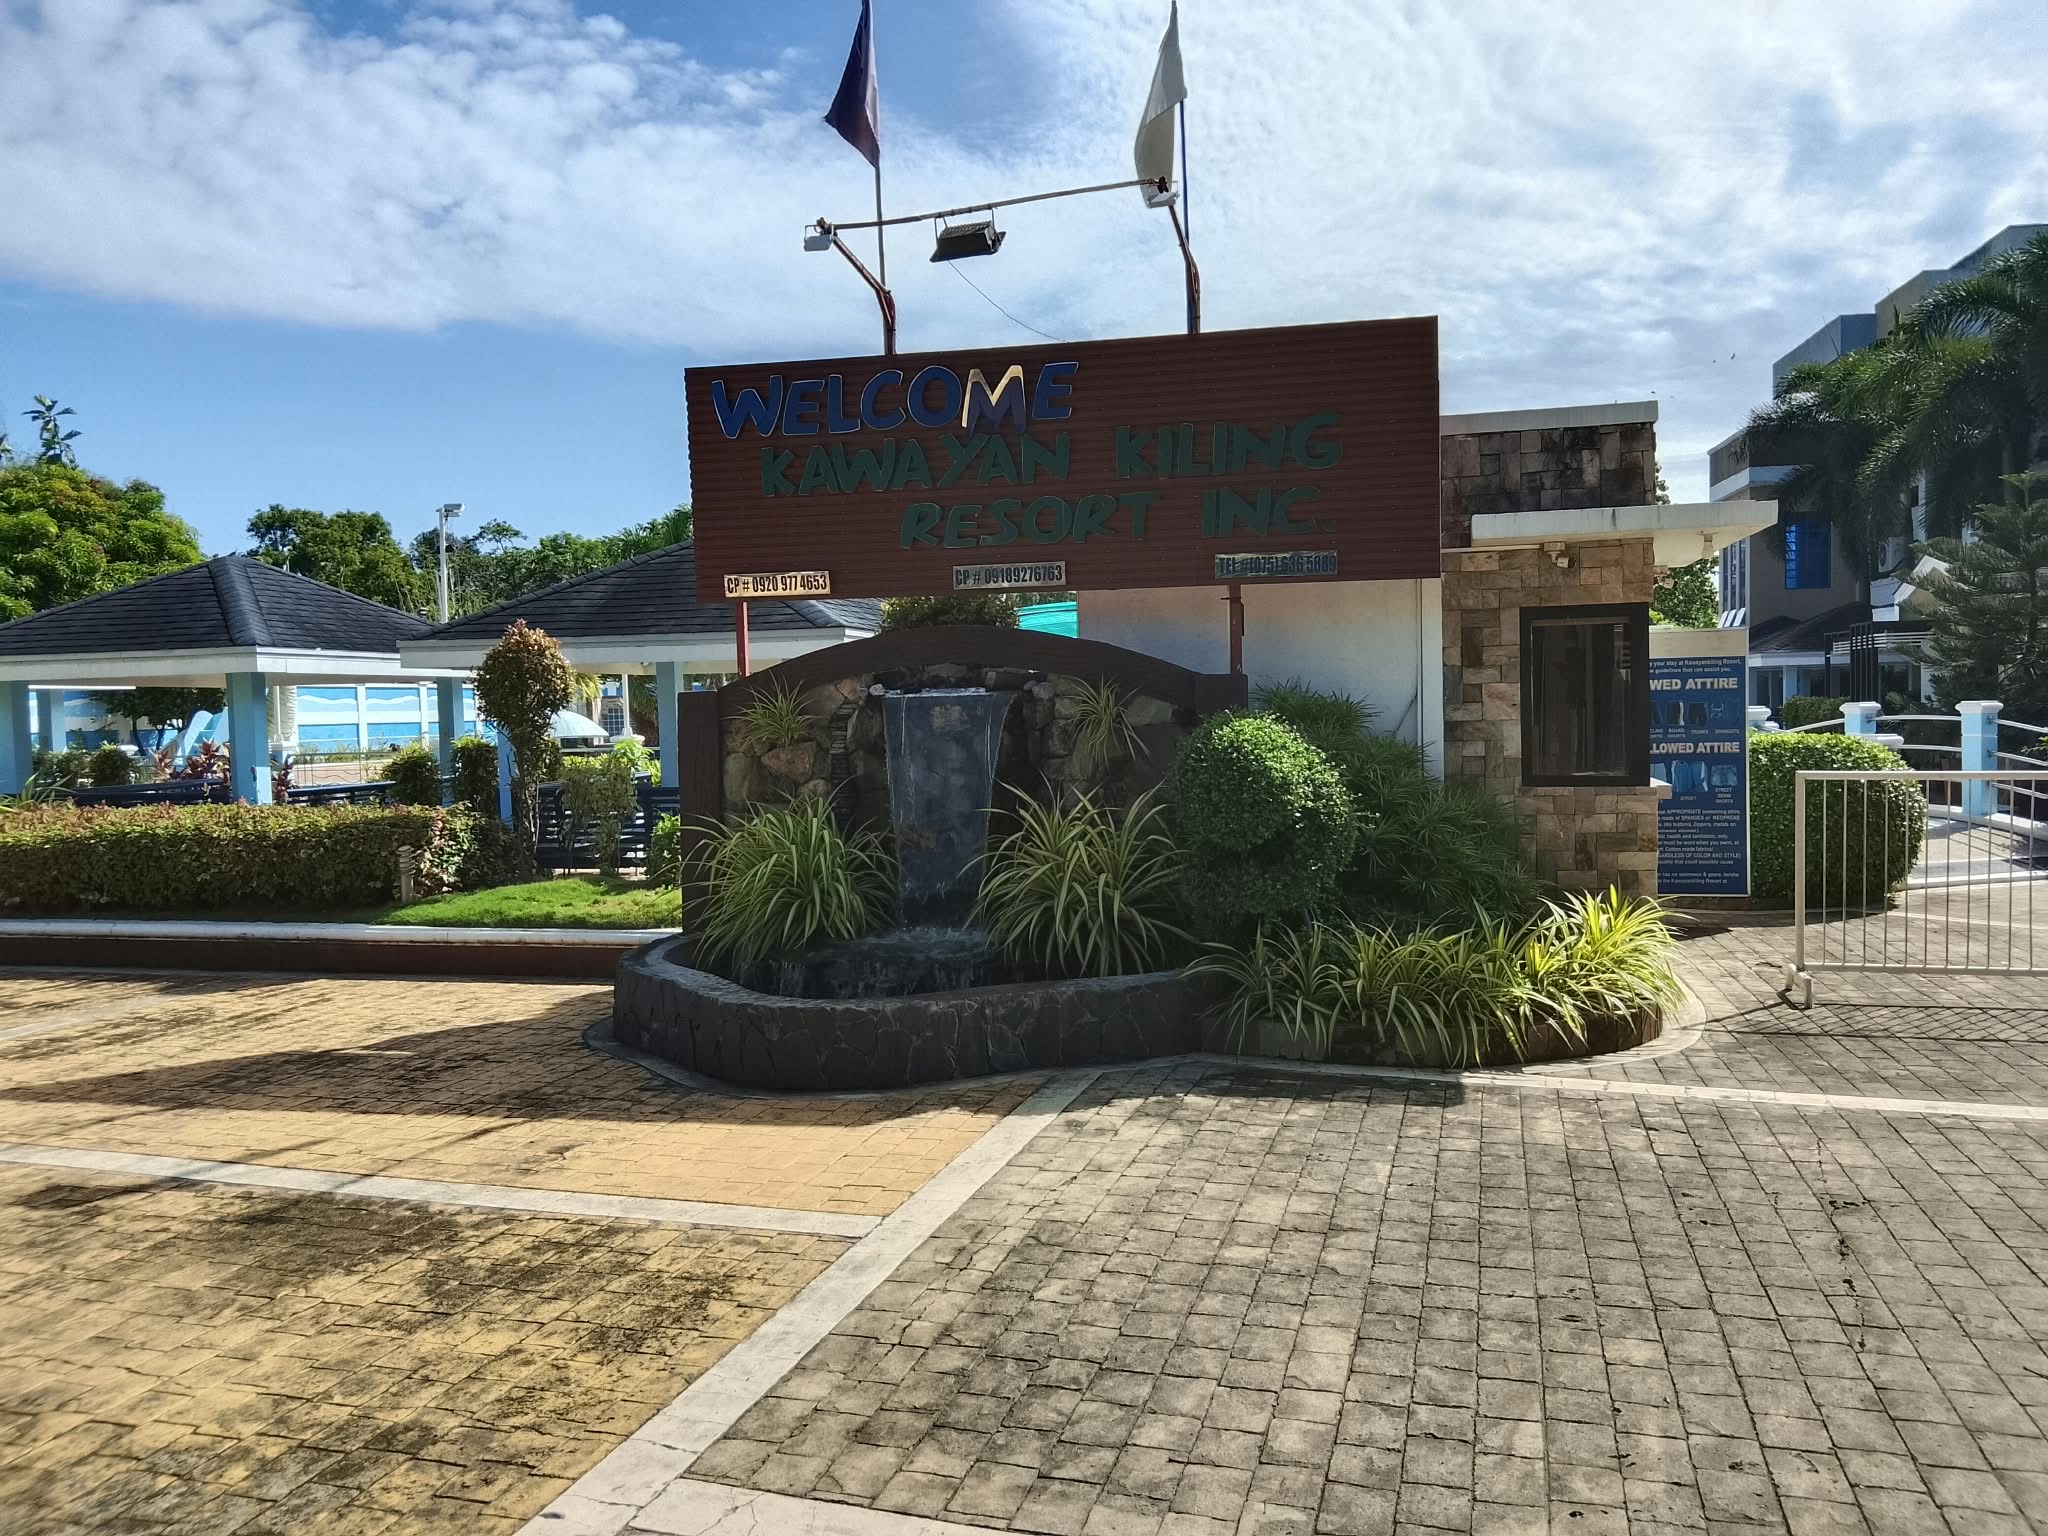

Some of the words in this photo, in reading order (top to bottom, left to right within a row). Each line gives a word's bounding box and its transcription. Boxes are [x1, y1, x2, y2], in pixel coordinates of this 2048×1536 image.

[711, 361, 1080, 439] WELCOME
[760, 432, 1071, 497] KAWAYAN
[1115, 412, 1343, 480] KILING
[902, 490, 1160, 549] RESORT
[955, 569, 970, 586] CP
[973, 571, 980, 585] #
[984, 565, 1063, 584] 09189276763
[1219, 557, 1239, 574] TEL
[727, 577, 740, 593] CP
[742, 579, 750, 592] #
[752, 576, 778, 592] 0920
[780, 575, 797, 591] 977
[799, 574, 827, 591] 4653
[1685, 677, 1739, 690] ATTIRE
[1649, 742, 1694, 754] LOWED
[1696, 741, 1740, 753] ATTIRE
